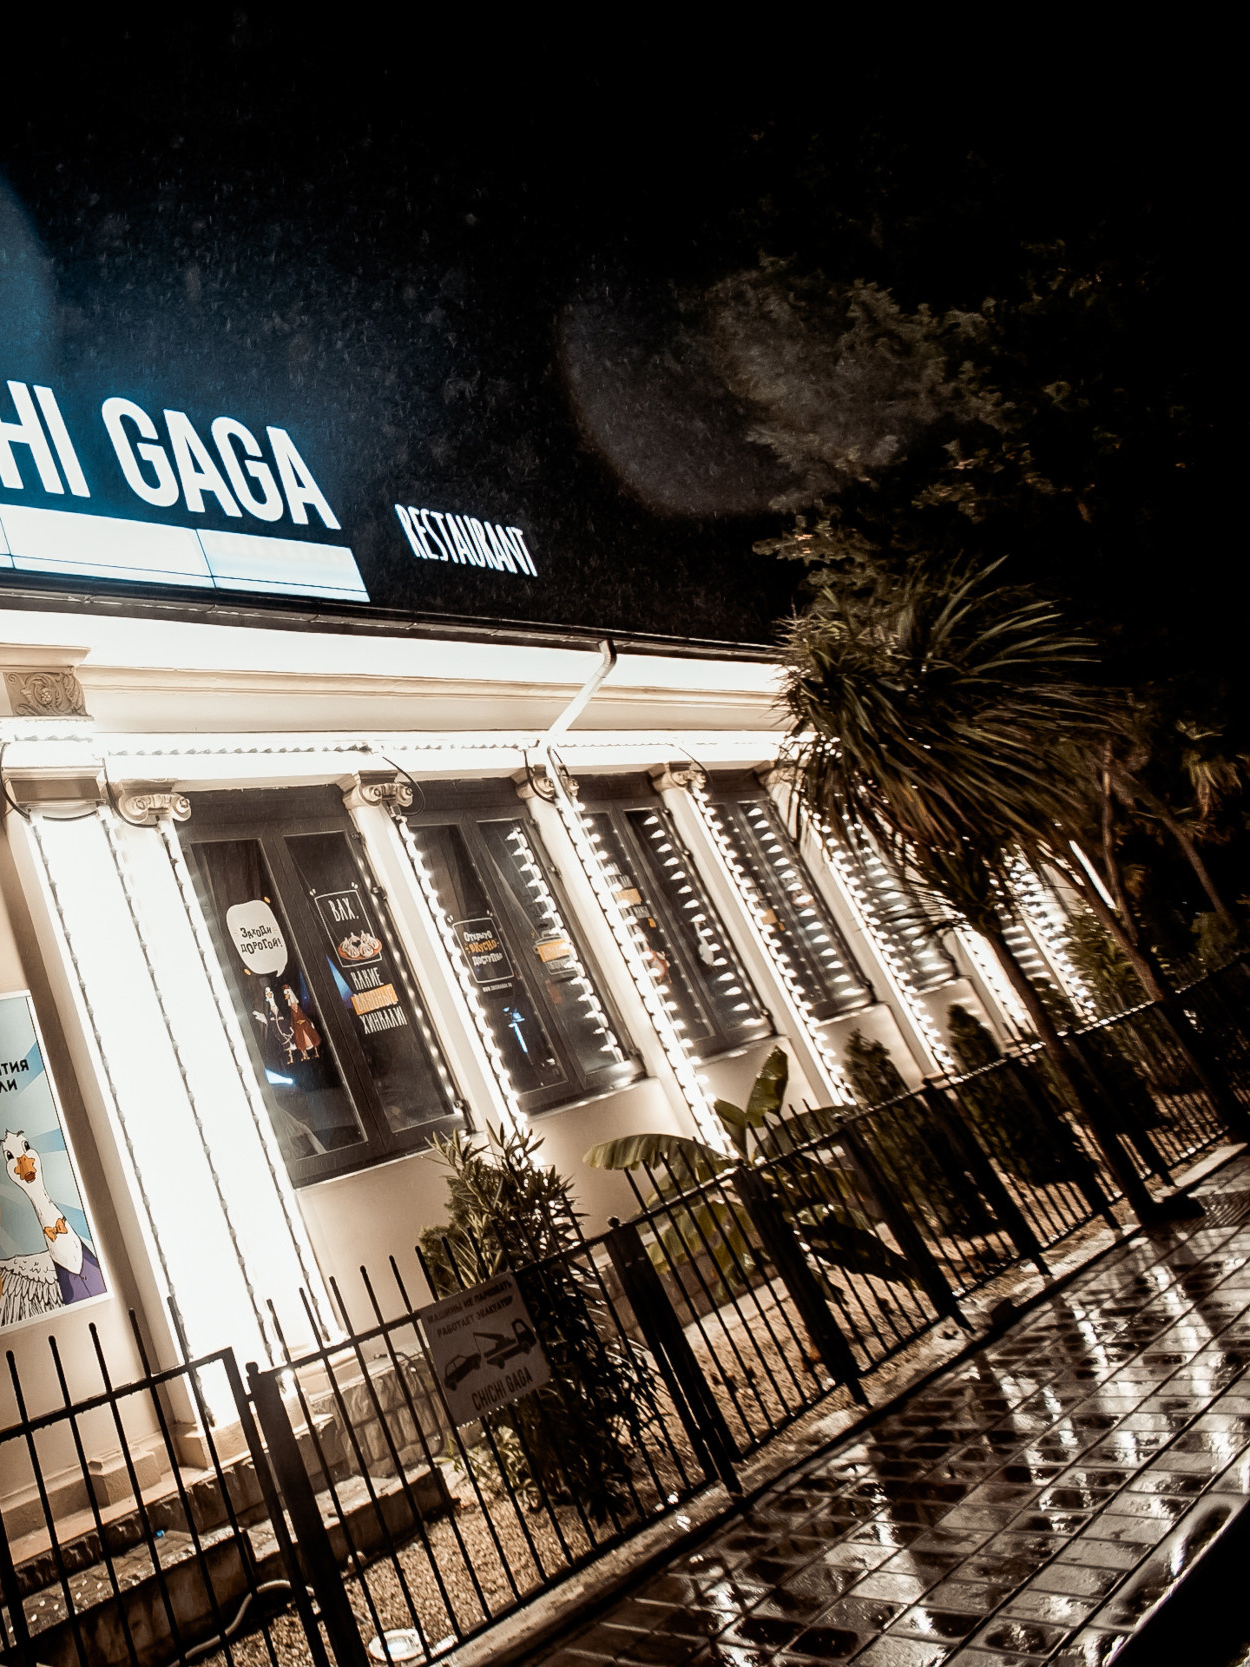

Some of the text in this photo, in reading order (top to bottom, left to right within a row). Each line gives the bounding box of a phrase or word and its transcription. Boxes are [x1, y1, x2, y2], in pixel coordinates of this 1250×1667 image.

[101, 396, 342, 530] GAGA
[394, 503, 539, 578] RESTAURANT
[437, 1314, 475, 1338] РАБОТАЕТ
[471, 1366, 534, 1412] CHICHI GAGA
